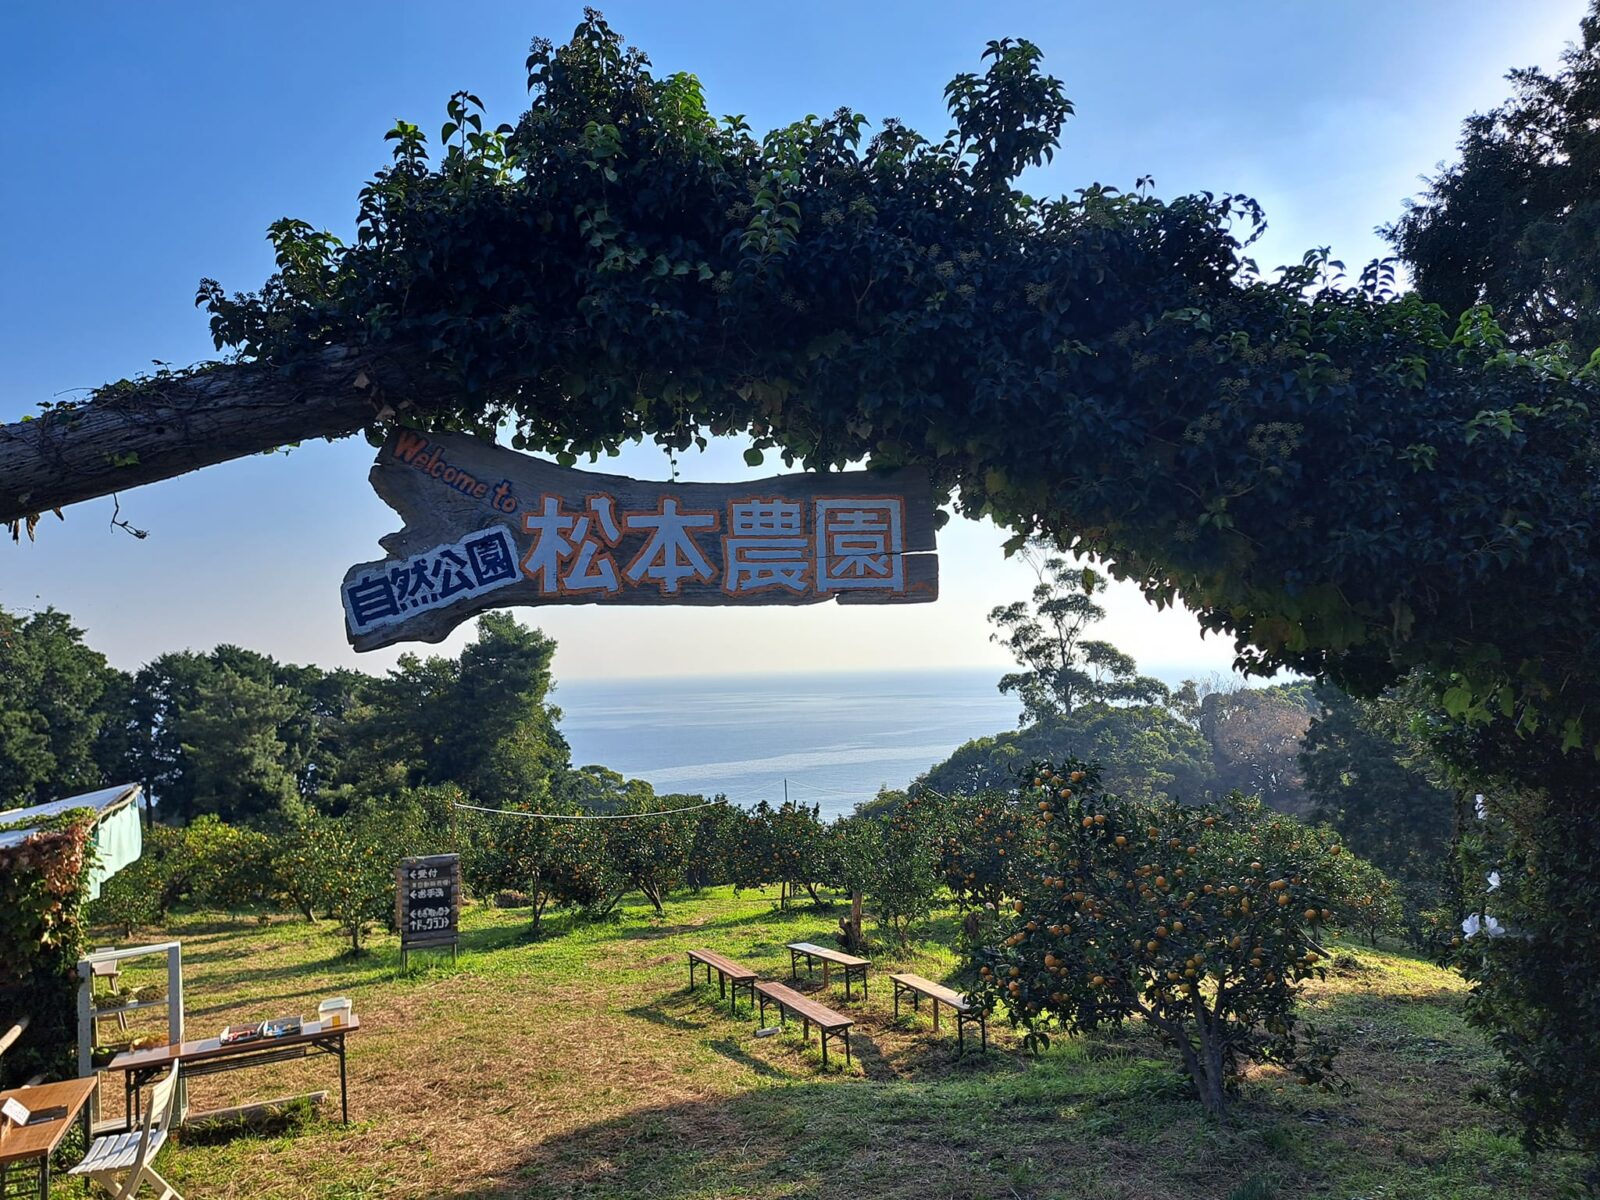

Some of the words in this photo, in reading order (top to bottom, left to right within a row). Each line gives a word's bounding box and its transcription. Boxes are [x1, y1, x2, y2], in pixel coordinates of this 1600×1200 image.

[392, 431, 489, 498] Welcome
[491, 479, 517, 513] to
[349, 532, 517, 627] 自然公園
[522, 492, 905, 598] 松本農園
